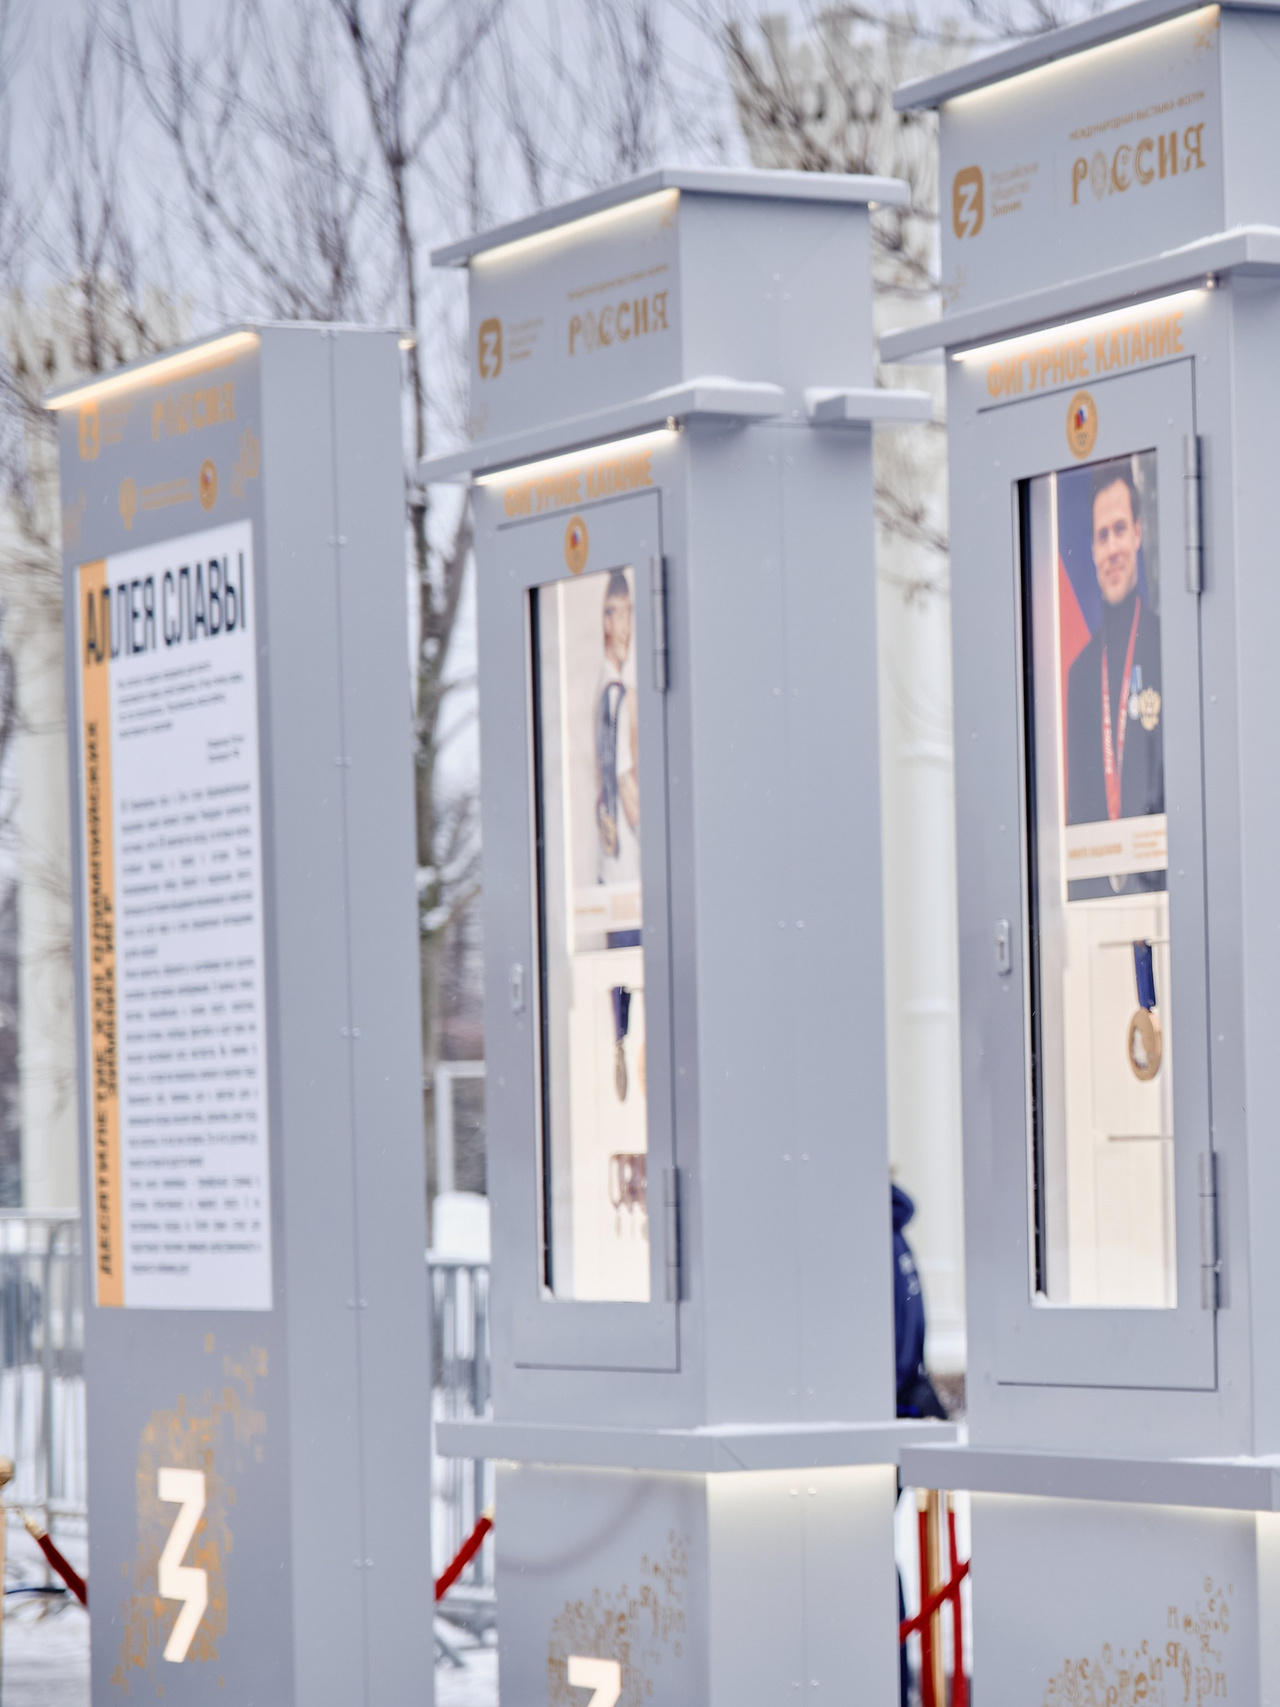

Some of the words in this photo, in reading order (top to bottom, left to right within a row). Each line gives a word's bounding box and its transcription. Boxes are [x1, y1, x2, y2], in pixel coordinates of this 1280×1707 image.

[1071, 121, 1206, 206] РОССИЯ
[986, 335, 1090, 399] ФИГУРНОЕ
[1094, 311, 1185, 374] КАТАНИЕ
[86, 575, 155, 667] АЛЛЕЯ
[163, 551, 246, 647] СЛАВЫ
